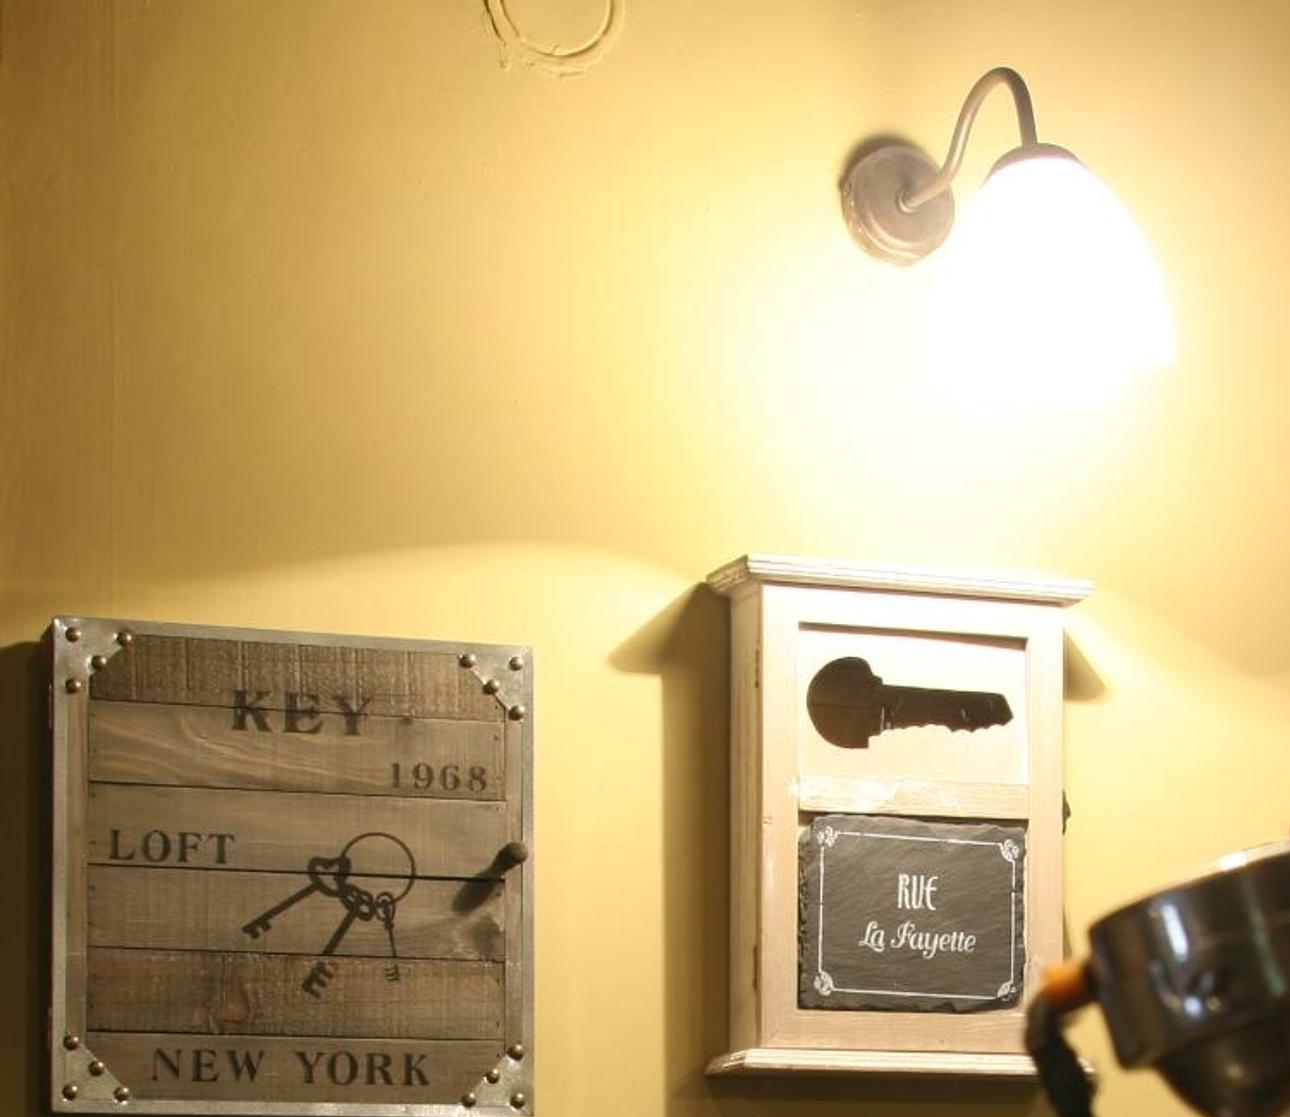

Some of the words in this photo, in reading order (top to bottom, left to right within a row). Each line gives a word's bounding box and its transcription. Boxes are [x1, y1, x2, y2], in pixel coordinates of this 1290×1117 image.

[231, 688, 372, 736] KEY
[390, 762, 488, 792] 1968
[108, 829, 235, 864] LOFT
[897, 874, 939, 911] RUE
[858, 921, 885, 952] La
[890, 920, 977, 960] Fayette
[151, 1048, 265, 1083] NEW
[294, 1051, 430, 1087] YORK
